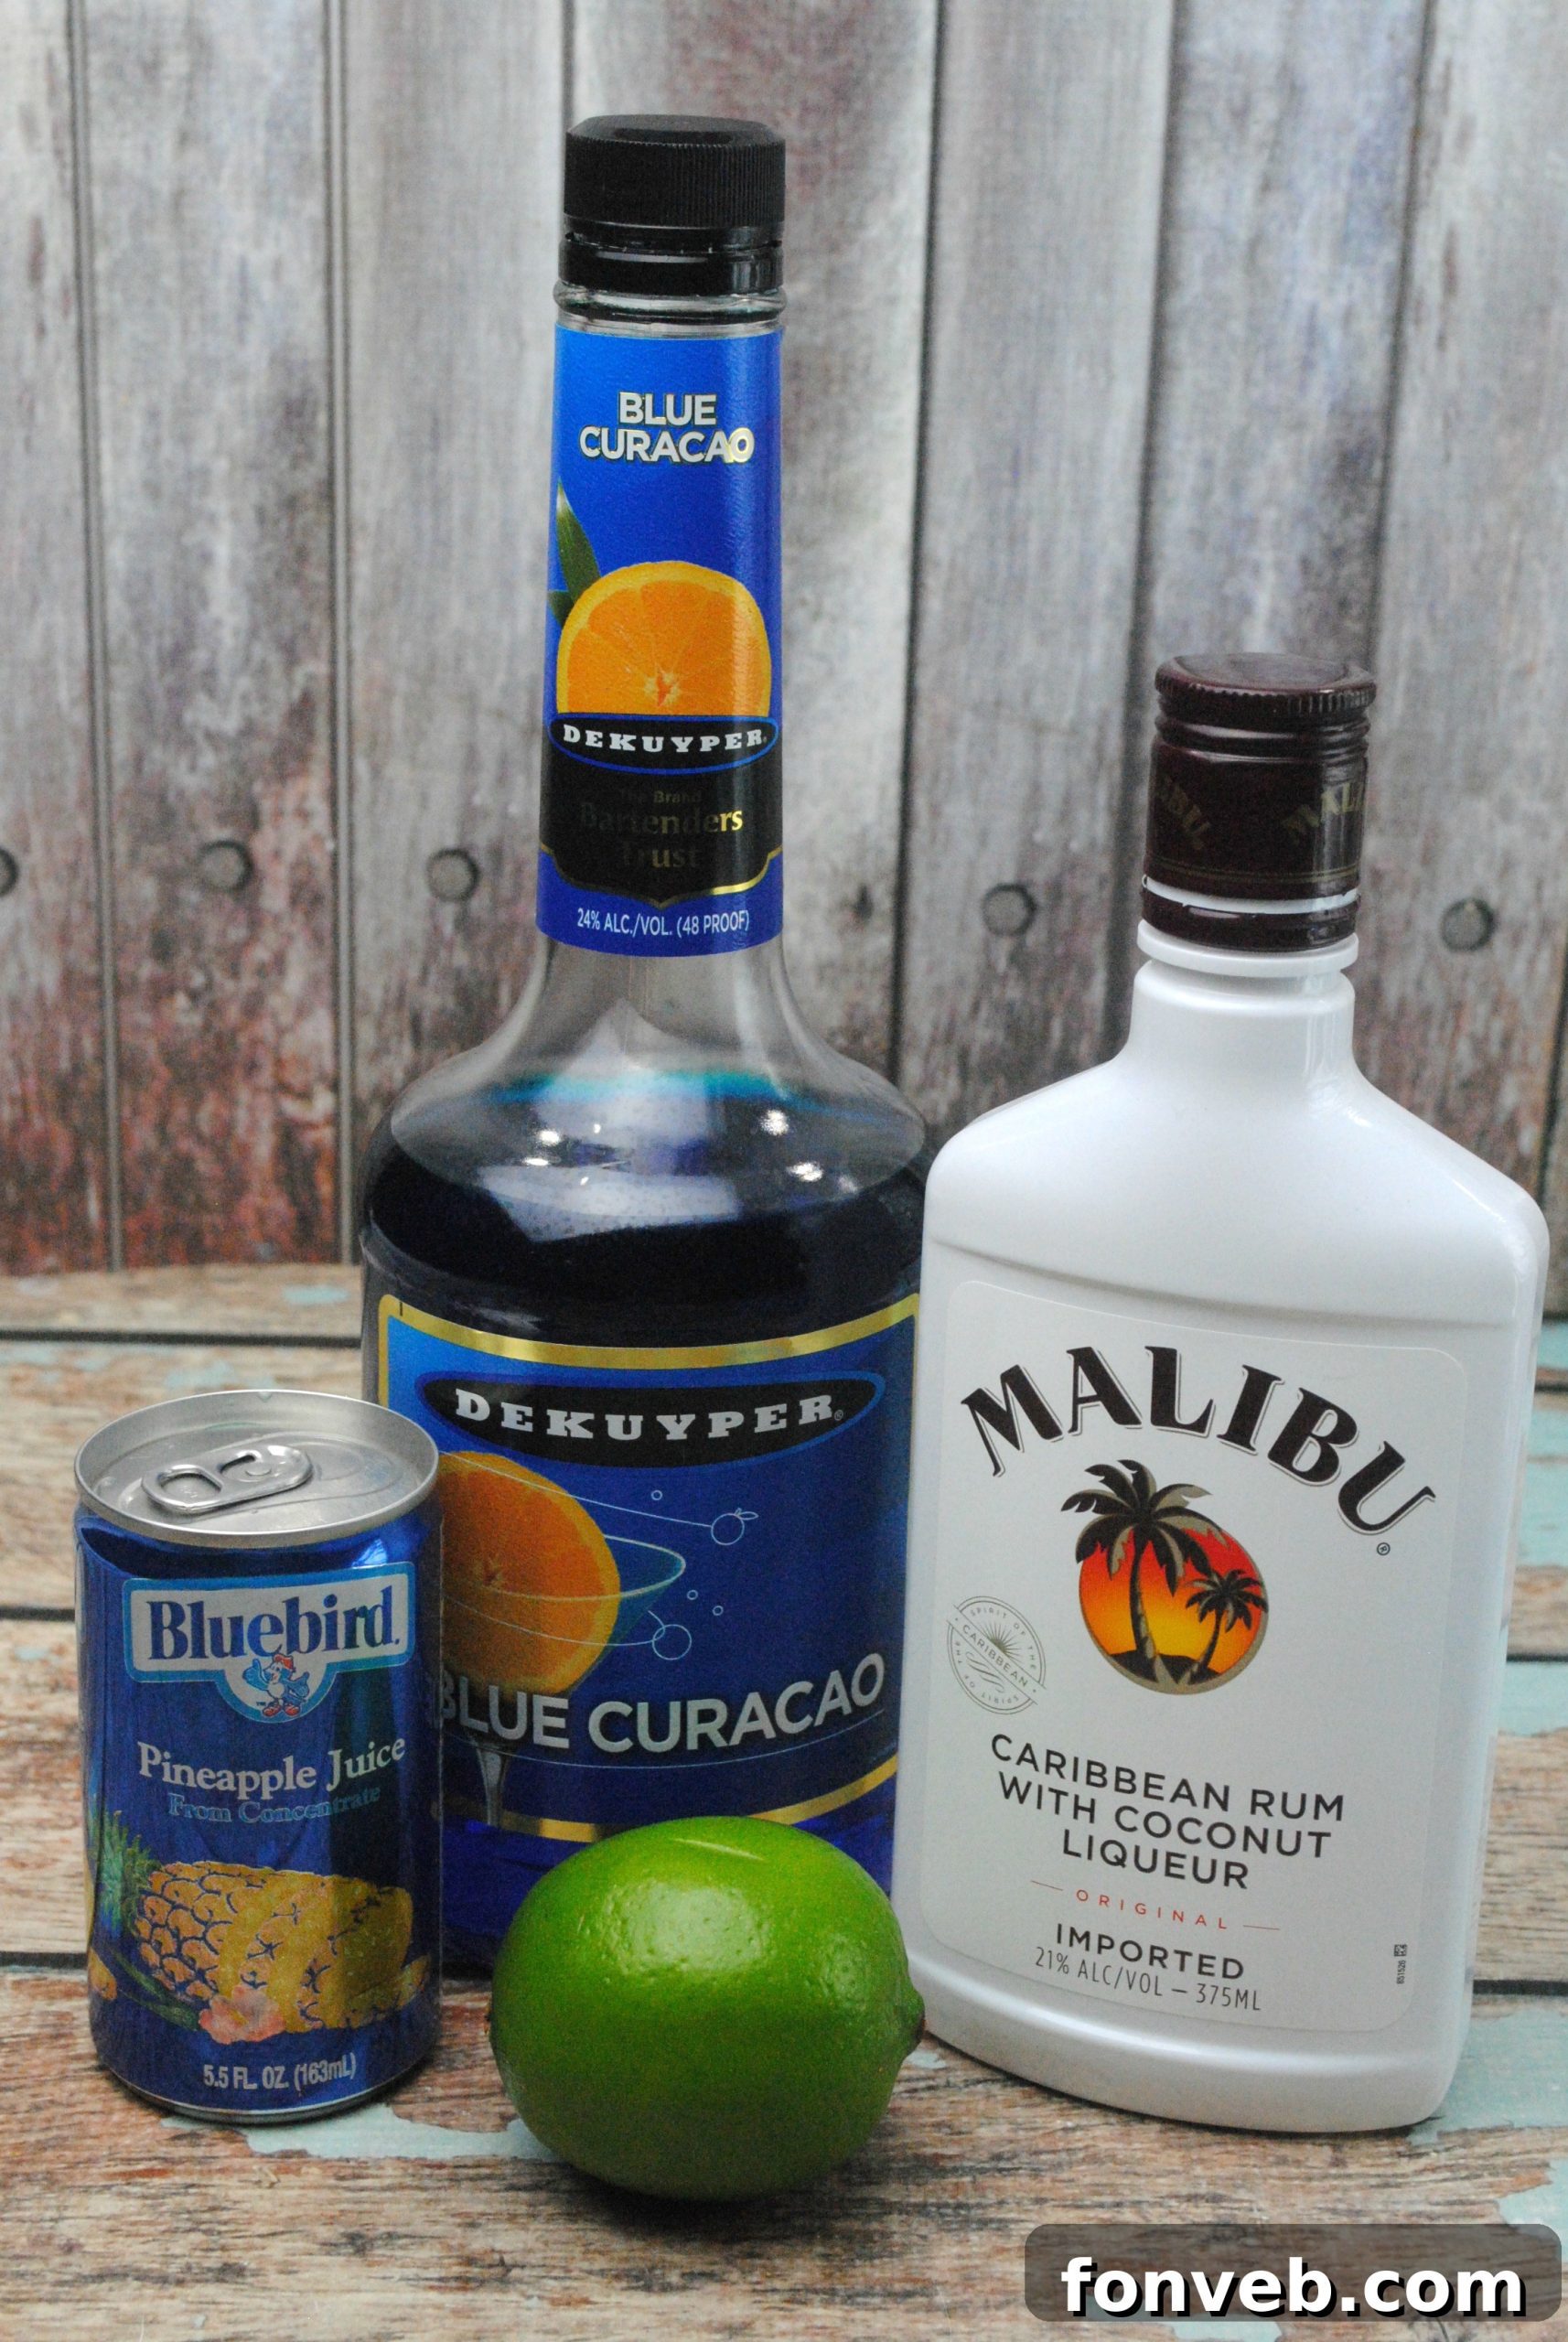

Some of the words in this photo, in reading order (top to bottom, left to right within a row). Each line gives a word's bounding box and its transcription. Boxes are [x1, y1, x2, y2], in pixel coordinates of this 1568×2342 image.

[618, 392, 717, 425] BLUE
[578, 425, 756, 464] CURACAO
[653, 790, 701, 804] Brand
[580, 802, 743, 836] Bartenders
[622, 840, 700, 869] Trust
[576, 908, 600, 930] 24%
[676, 915, 700, 939] (48
[703, 909, 750, 934] PROOF)
[961, 1346, 1436, 1535] MALIBU
[971, 1607, 1007, 1618] SPIRIT
[962, 1625, 1028, 1687] CARIBBEAN
[587, 1653, 885, 1753] CURACAO
[137, 1742, 317, 1799] Pineapple
[327, 1738, 405, 1791] Juice
[992, 1735, 1230, 1811] CARIBBEAN
[1250, 1789, 1345, 1821] RUM
[168, 1793, 232, 1822] From
[239, 1788, 381, 1823] Concentrate
[998, 1771, 1097, 1824] WITH
[1114, 1805, 1332, 1859] COCONUT
[1062, 1830, 1249, 1888] LIQUEUR
[1077, 1889, 1228, 1929] ORIGINAL
[1056, 1924, 1244, 1979] IMPORTED
[1035, 1947, 1070, 1975] 21%
[1078, 1959, 1163, 1995] ALC/VOL
[1196, 1983, 1262, 2011] 375ML
[203, 2064, 229, 2089] 5.5
[263, 2066, 289, 2090] OZ.
[294, 2052, 357, 2091] (163mL)
